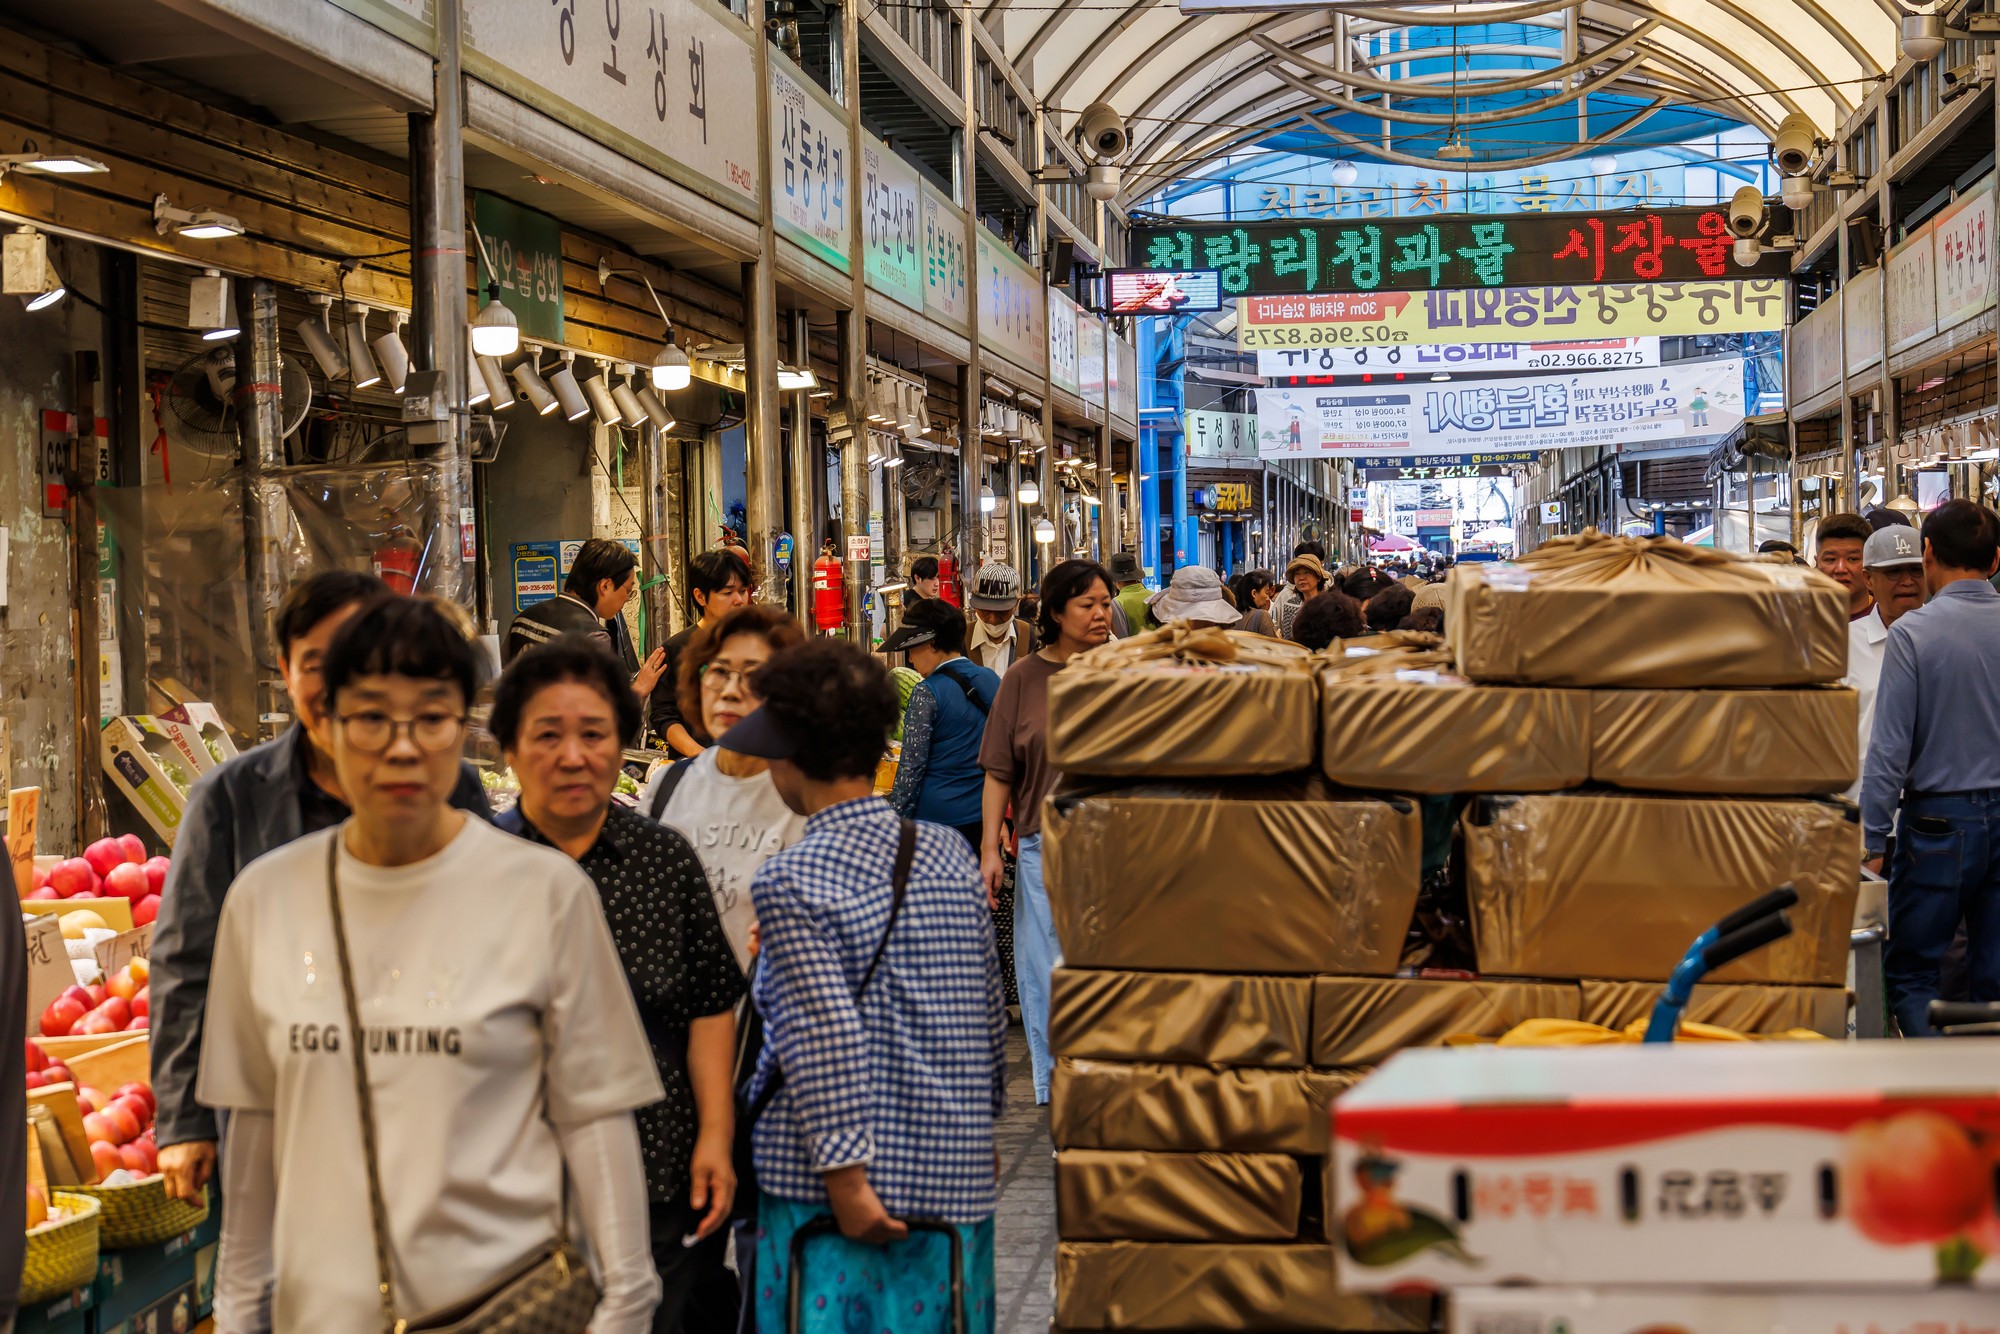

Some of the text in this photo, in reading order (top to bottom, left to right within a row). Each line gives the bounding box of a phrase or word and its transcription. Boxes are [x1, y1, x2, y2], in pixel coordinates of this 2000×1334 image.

[781, 104, 844, 231] 삼동청과
[866, 172, 915, 271] 장군상회
[535, 250, 559, 306] 상회
[927, 216, 965, 304] 칠복청과
[1540, 351, 1644, 367] 02.966.8275
[1197, 417, 1257, 450] 두성상사
[288, 1023, 462, 1057] EGG UNTING
